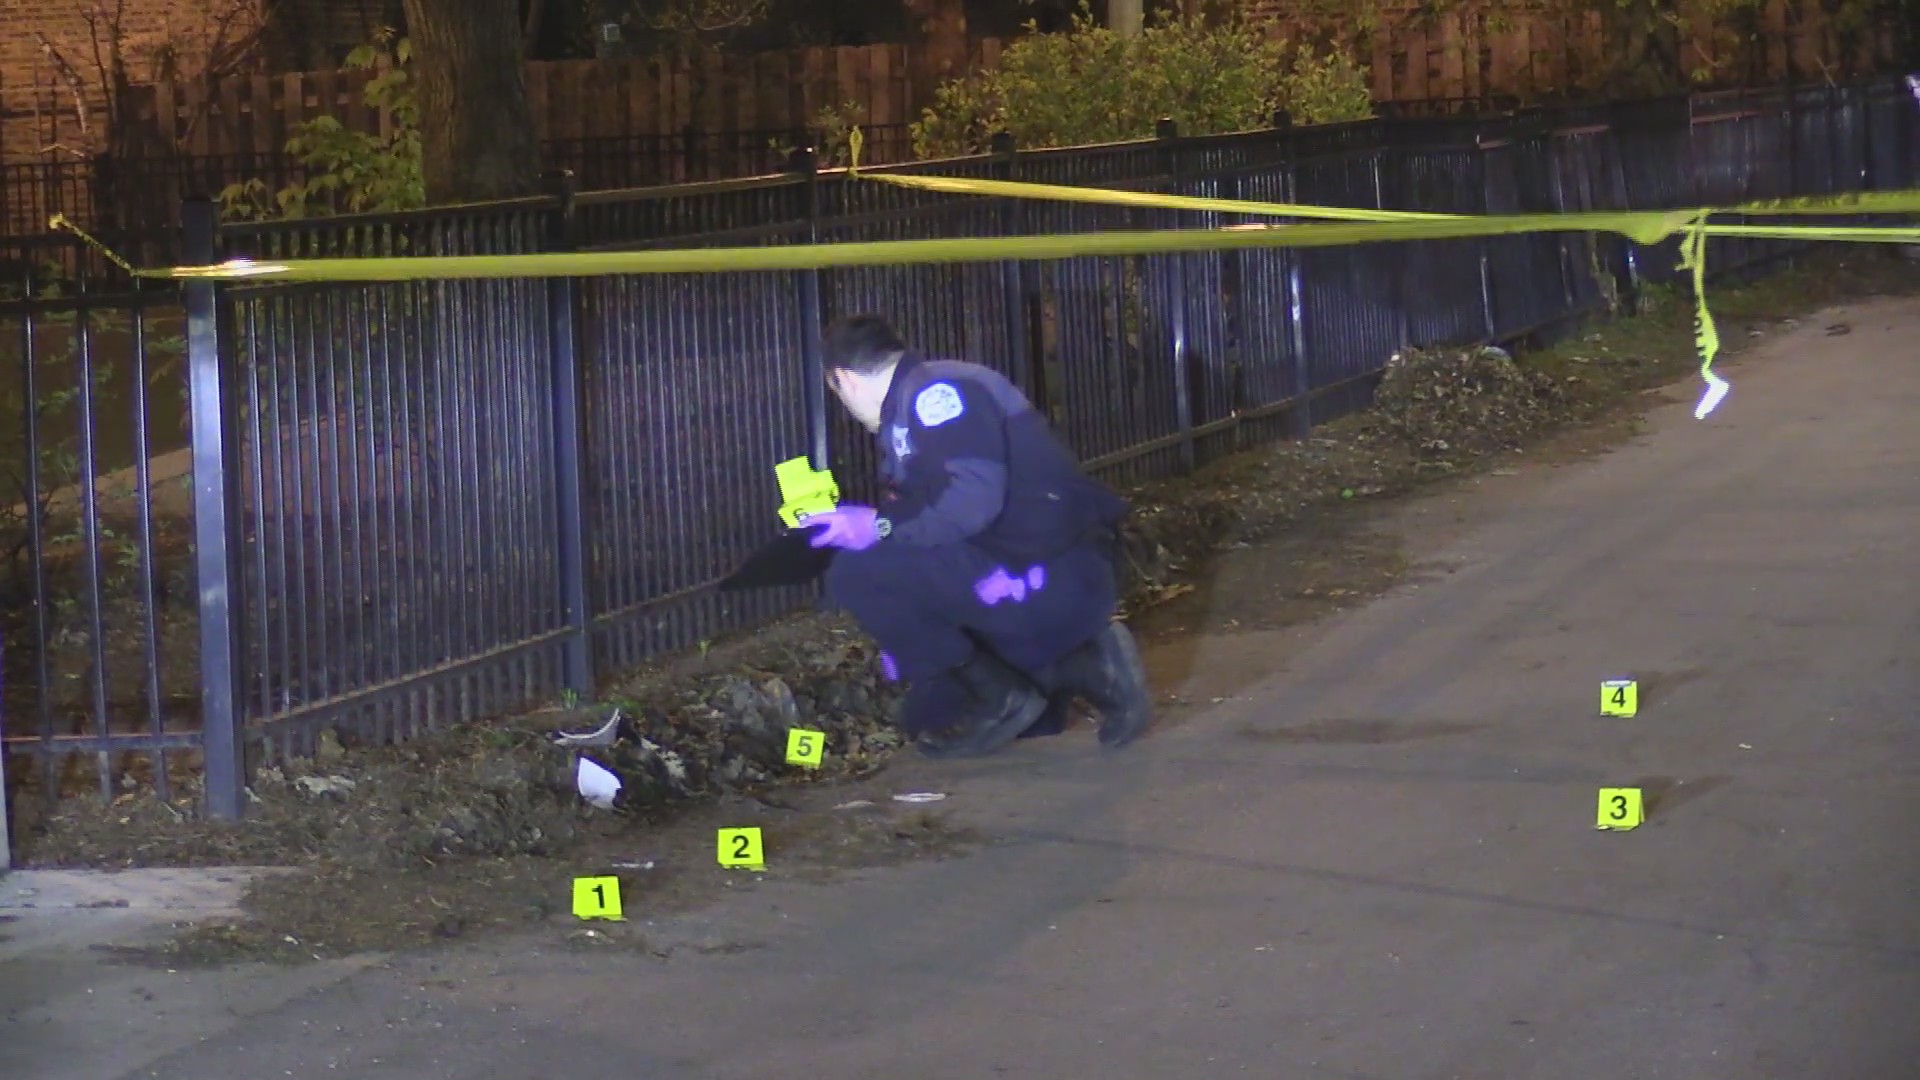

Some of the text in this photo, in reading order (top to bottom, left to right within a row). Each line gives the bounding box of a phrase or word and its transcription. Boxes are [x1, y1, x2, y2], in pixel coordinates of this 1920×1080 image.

[1611, 687, 1626, 708] 4
[797, 735, 813, 757] 5
[1610, 795, 1627, 820] 3
[732, 835, 751, 859] 2
[592, 884, 605, 909] 1
